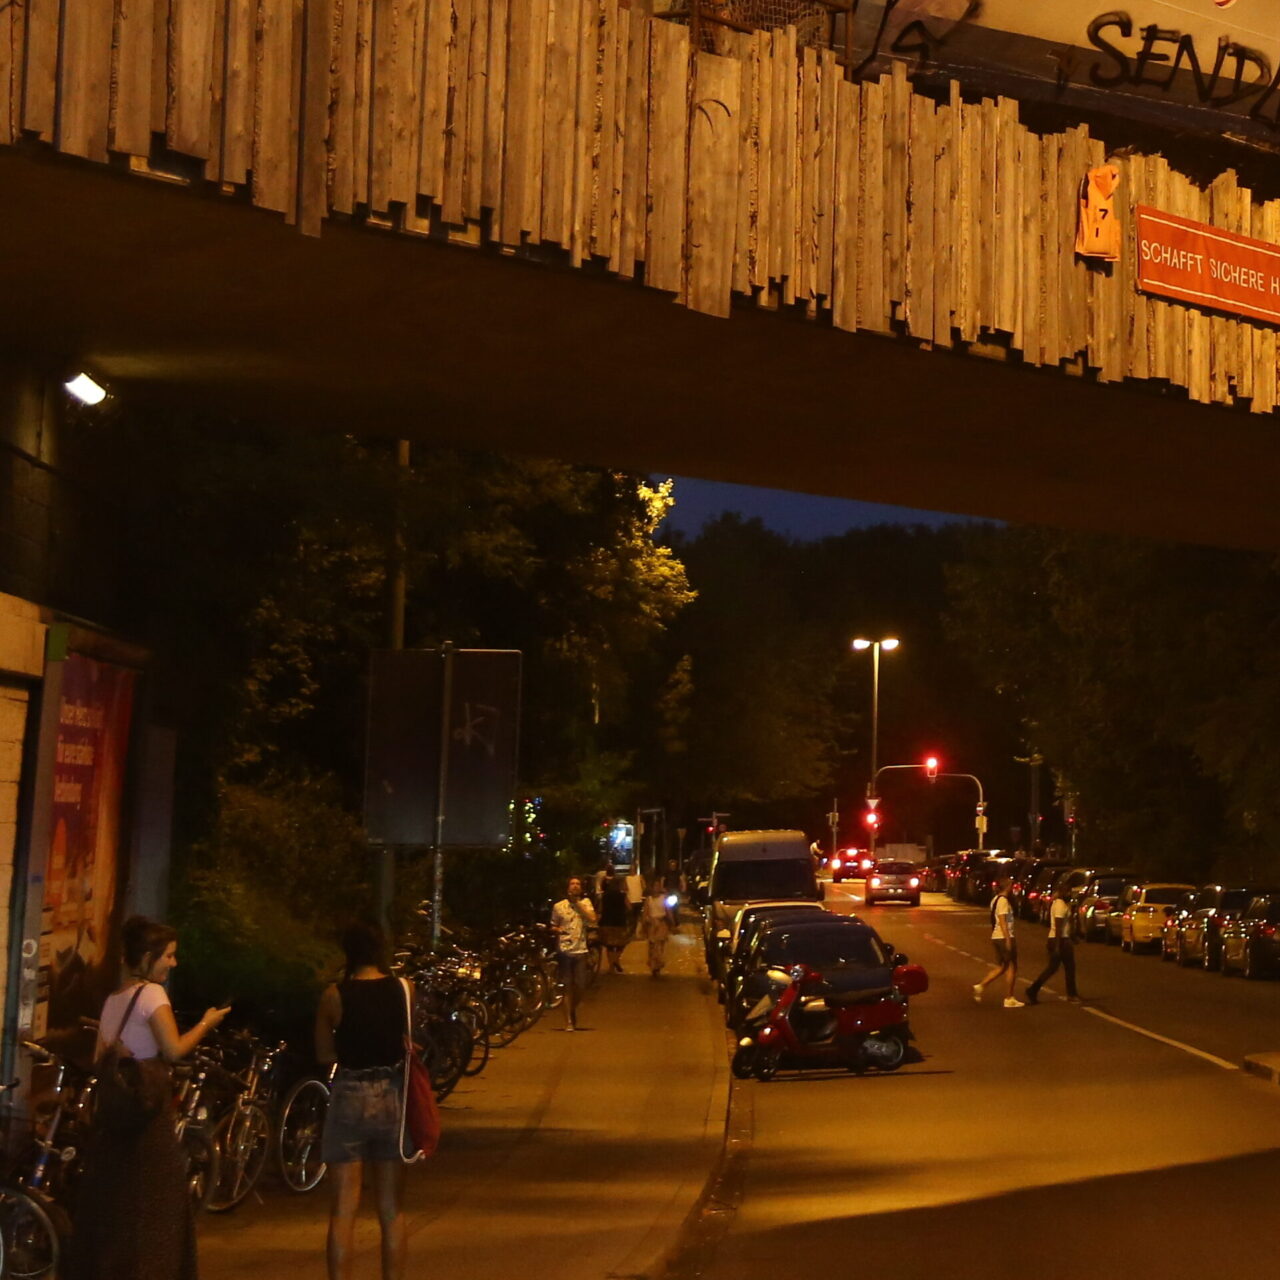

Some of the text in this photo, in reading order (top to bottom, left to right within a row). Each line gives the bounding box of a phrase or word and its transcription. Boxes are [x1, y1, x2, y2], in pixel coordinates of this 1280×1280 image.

[1098, 208, 1109, 220] 7
[1141, 239, 1203, 274] SCHAFFT
[1209, 258, 1265, 292] SICHERE
